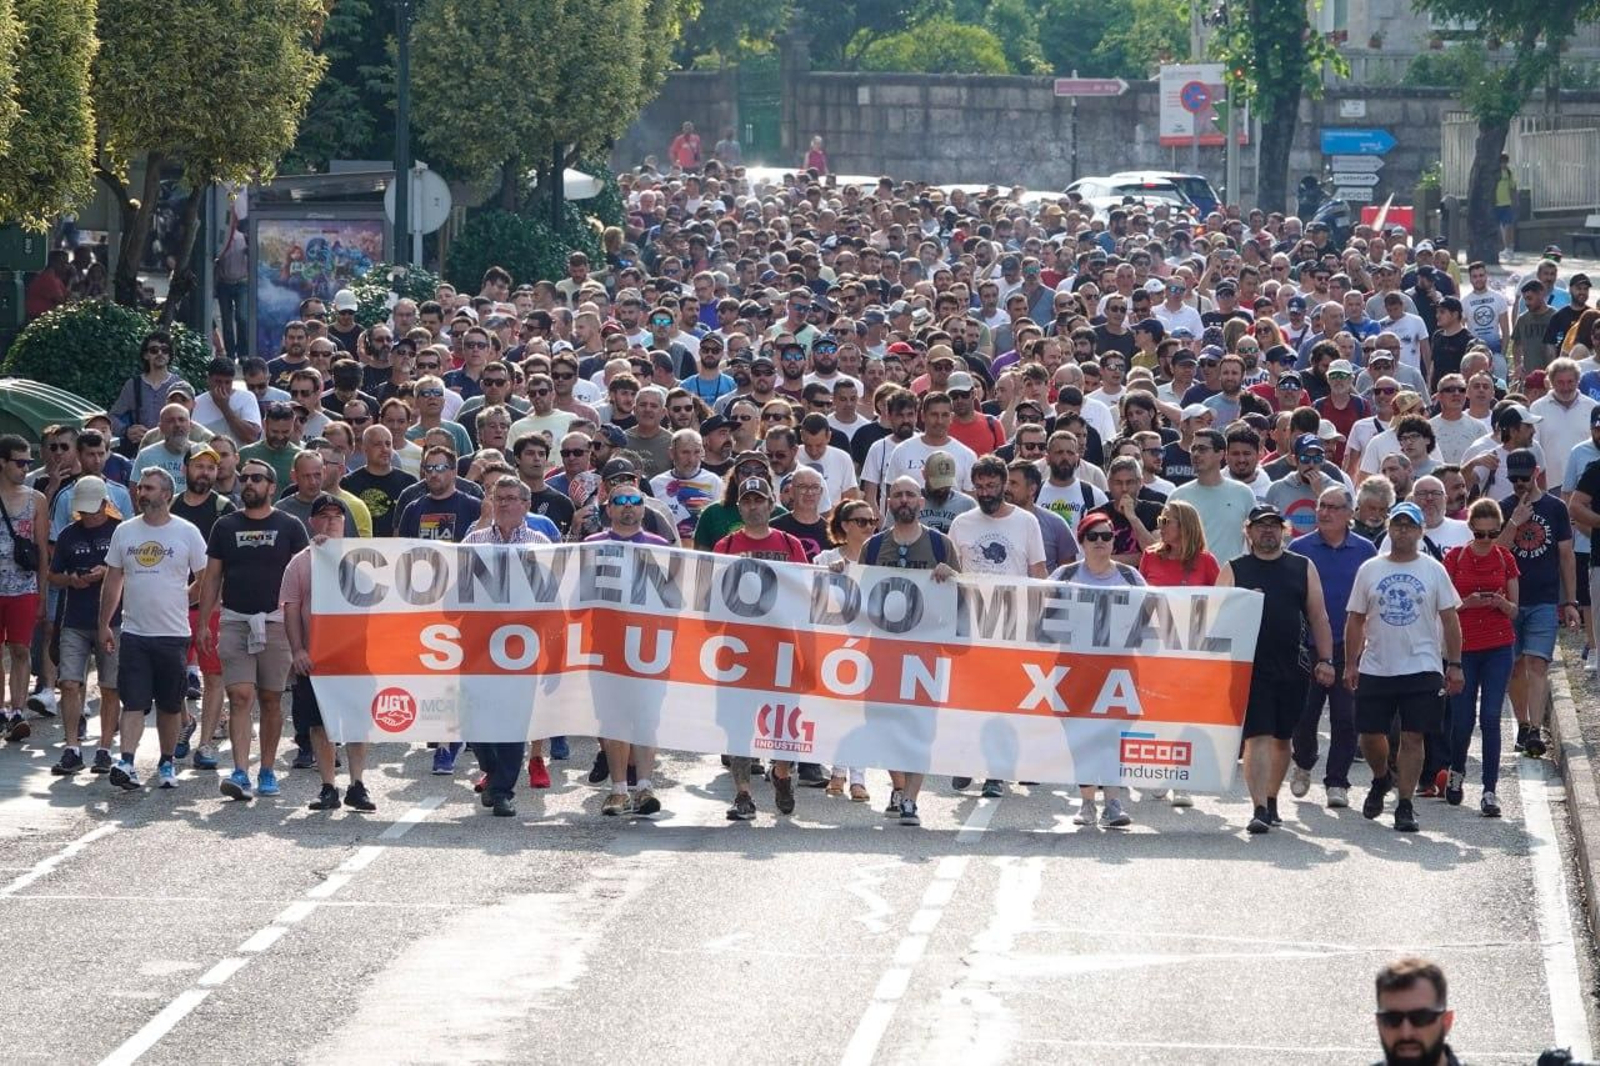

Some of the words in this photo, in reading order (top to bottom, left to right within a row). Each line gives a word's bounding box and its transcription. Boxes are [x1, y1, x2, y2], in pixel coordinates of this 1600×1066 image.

[420, 528, 452, 539] FILA
[338, 545, 778, 618] CONVENIO
[809, 571, 924, 634] DO
[956, 582, 1232, 652] METAL
[419, 622, 952, 703] SOLUCIÓN
[1017, 663, 1144, 716] XA
[378, 694, 410, 712] UGT
[757, 703, 815, 741] CIG
[755, 739, 812, 753] INDUSTRIA
[1124, 743, 1188, 762] CCOO
[1119, 764, 1189, 780] industria
